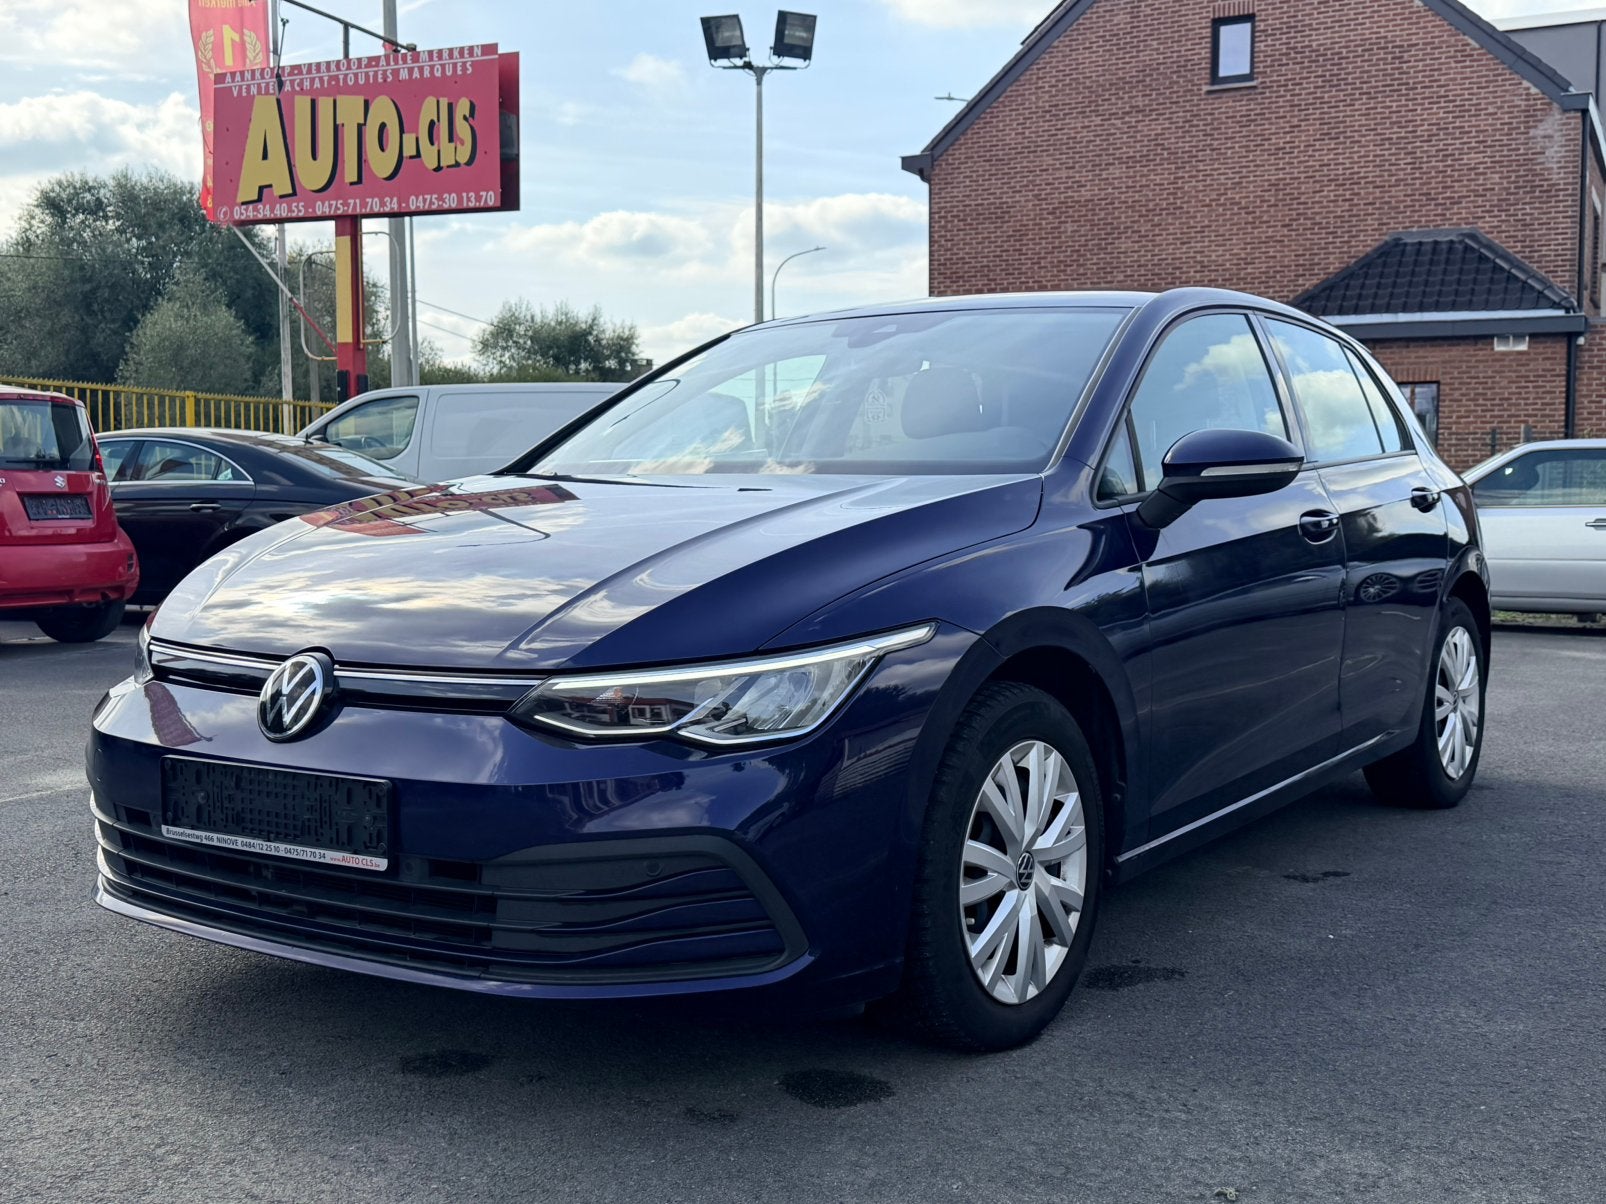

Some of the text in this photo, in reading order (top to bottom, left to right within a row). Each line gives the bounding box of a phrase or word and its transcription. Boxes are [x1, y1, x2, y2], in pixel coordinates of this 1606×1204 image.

[420, 45, 482, 63] MERKEN
[400, 61, 473, 81] MARQUES
[236, 95, 475, 205] AUTO-CLS
[233, 202, 305, 219] 054-34.40.55
[315, 197, 398, 215] 0475-71.70.34
[462, 191, 495, 206] 13.70
[204, 834, 215, 843] 466
[216, 836, 239, 847] NINOVE
[318, 852, 326, 860] 34
